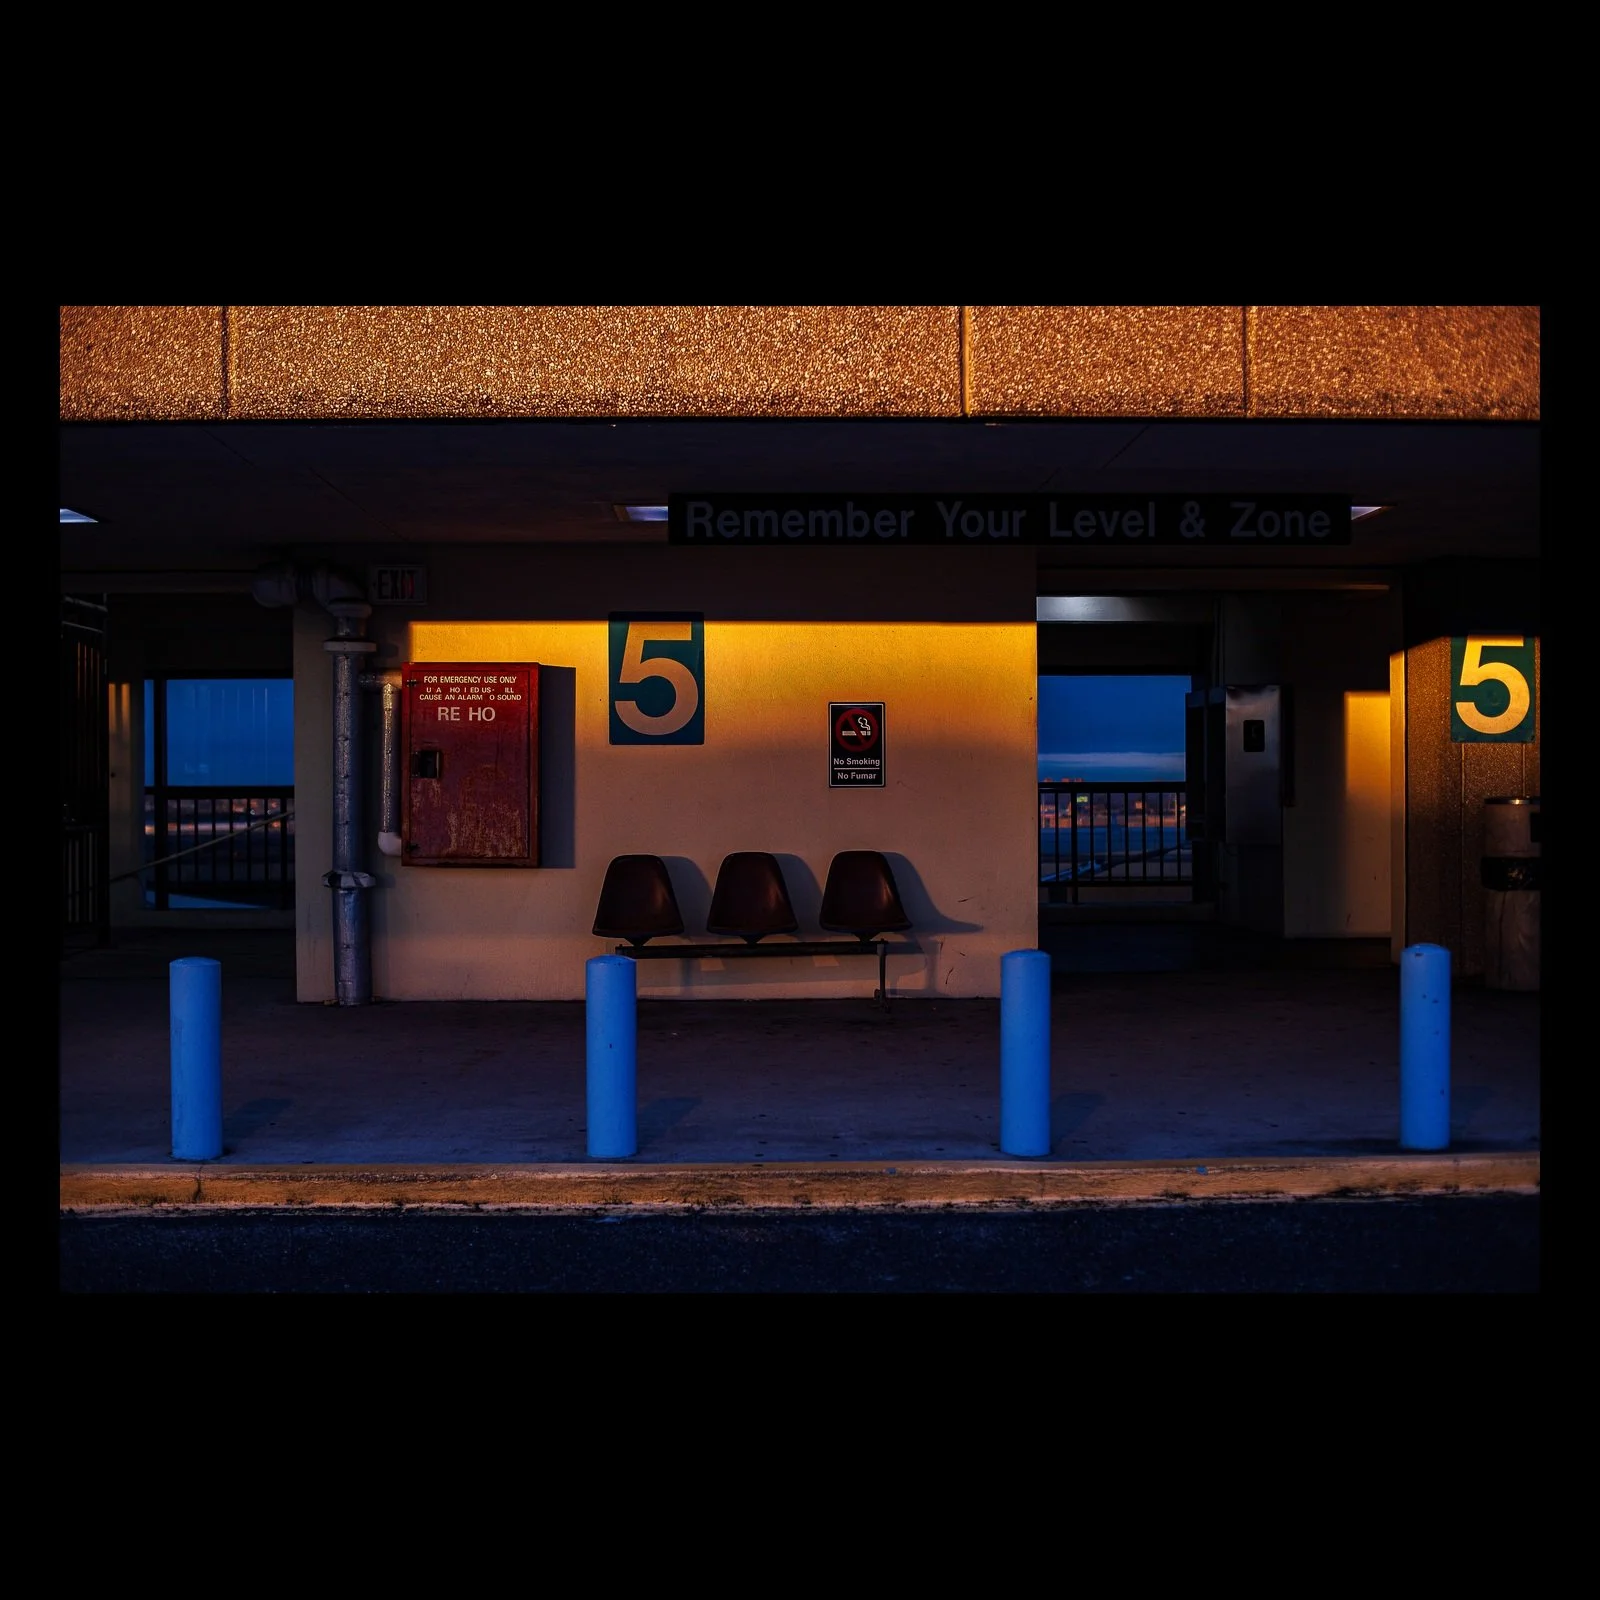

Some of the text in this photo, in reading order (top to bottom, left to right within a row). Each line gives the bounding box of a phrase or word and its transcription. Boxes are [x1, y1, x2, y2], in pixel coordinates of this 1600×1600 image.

[685, 500, 1332, 539] Remember Your Level & Zone
[378, 569, 415, 600] EXIT
[423, 675, 517, 684] FOR EMERGENCY USE ONLY
[614, 620, 699, 736] 5
[1455, 630, 1531, 735] 5
[833, 757, 880, 767] No Smoking
[837, 771, 877, 780] No Fumar
